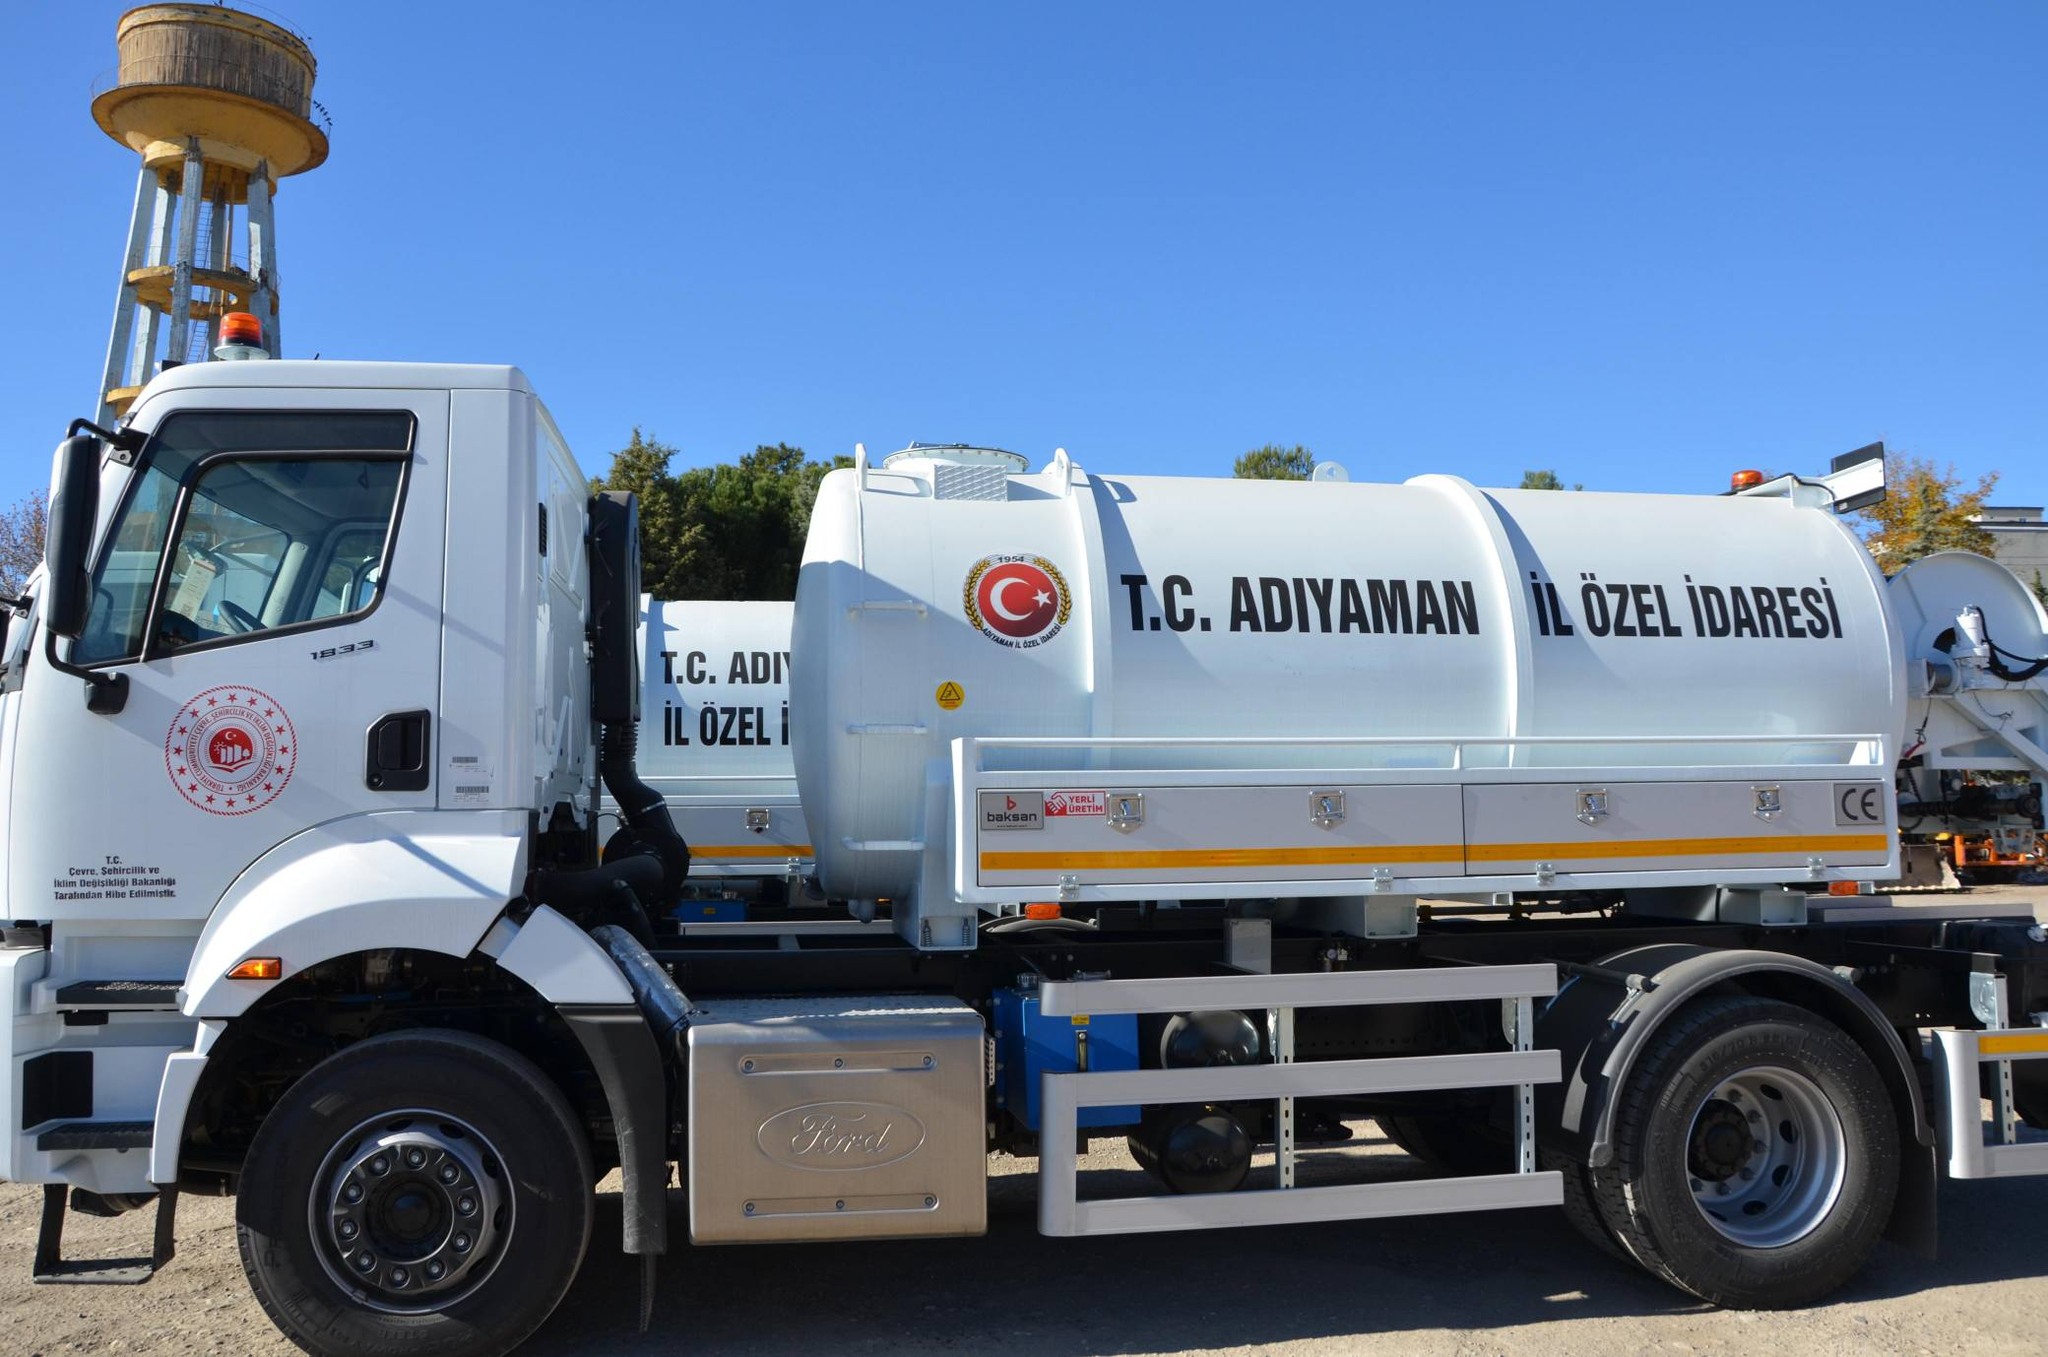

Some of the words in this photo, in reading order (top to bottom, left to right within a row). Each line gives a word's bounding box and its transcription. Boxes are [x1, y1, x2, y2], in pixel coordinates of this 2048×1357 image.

[997, 555, 1025, 563] 1954
[1120, 574, 1212, 632] T.C.
[1229, 576, 1480, 635] ADIYAMAN
[1529, 571, 1574, 636] İL
[1580, 572, 1683, 637] ÖZEL
[1684, 574, 1843, 639] İDARESİ
[982, 627, 1014, 648] ADIYAMAN
[1015, 640, 1022, 649] İL
[1023, 639, 1041, 649] ÖZEL
[1040, 623, 1062, 644] İDARESİ
[310, 640, 374, 660] 1833
[660, 651, 716, 684] T.C.
[664, 700, 690, 746] İL
[700, 701, 771, 746] ÖZEL
[1068, 794, 1095, 803] YERLİ
[1841, 788, 1878, 820] CE
[1068, 803, 1103, 813] ÜRETİM
[987, 811, 1038, 822] baksan
[105, 855, 123, 865] T.C.
[101, 866, 146, 876] Şehircilik
[148, 866, 160, 875] ve
[53, 877, 77, 888] İklim
[80, 877, 129, 889] Değişikliği
[131, 876, 176, 888] Bakanlığı
[54, 890, 103, 900] Tarafından
[105, 889, 127, 899] Hibe
[129, 888, 176, 899] Edilmiştir.
[791, 1112, 892, 1155] Ford
